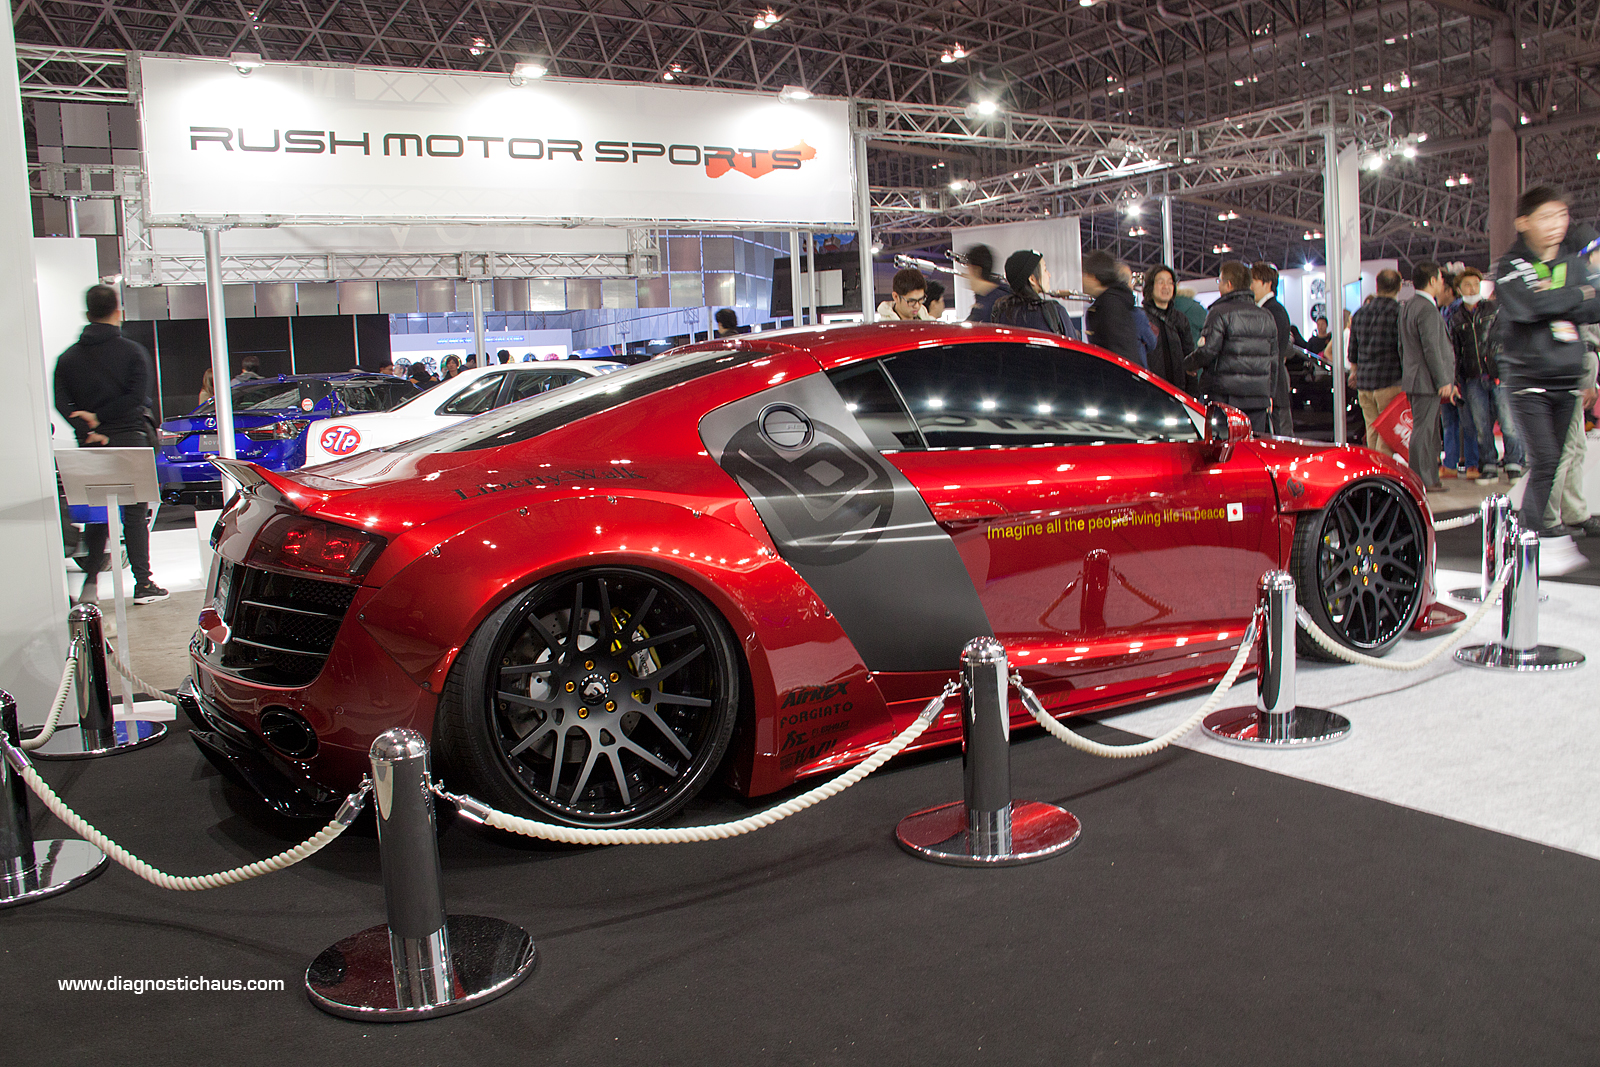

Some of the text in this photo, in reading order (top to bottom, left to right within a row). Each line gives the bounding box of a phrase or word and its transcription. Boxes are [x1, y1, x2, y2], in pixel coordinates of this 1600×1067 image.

[189, 125, 802, 170] RUSH MOTOR SPORTS
[322, 427, 357, 452] STP
[454, 466, 648, 501] Liberty Walk
[987, 507, 1225, 541] Imagine all the people living life in peace
[781, 701, 853, 729] FORGIATO
